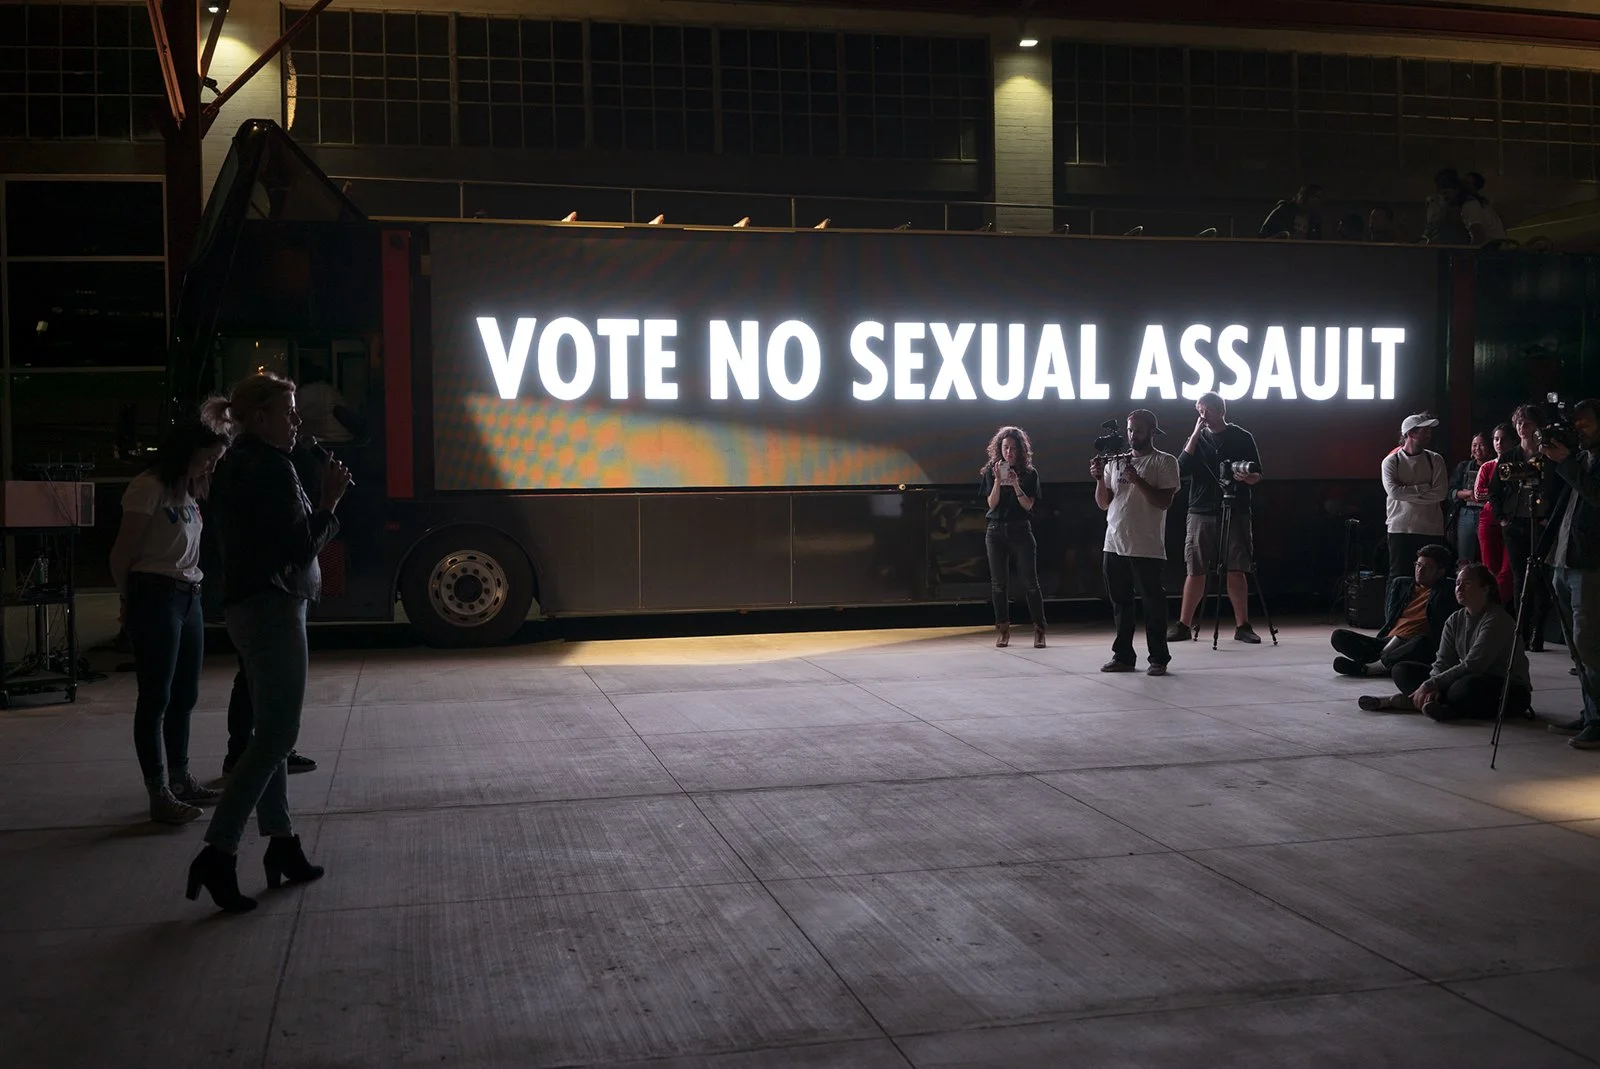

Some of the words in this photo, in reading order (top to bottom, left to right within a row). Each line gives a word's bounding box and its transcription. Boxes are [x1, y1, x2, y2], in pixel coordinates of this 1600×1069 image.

[476, 316, 679, 401] VOTE
[709, 319, 821, 401] NO
[850, 320, 1110, 401] SEXUAL
[1130, 324, 1406, 401] ASSAULT
